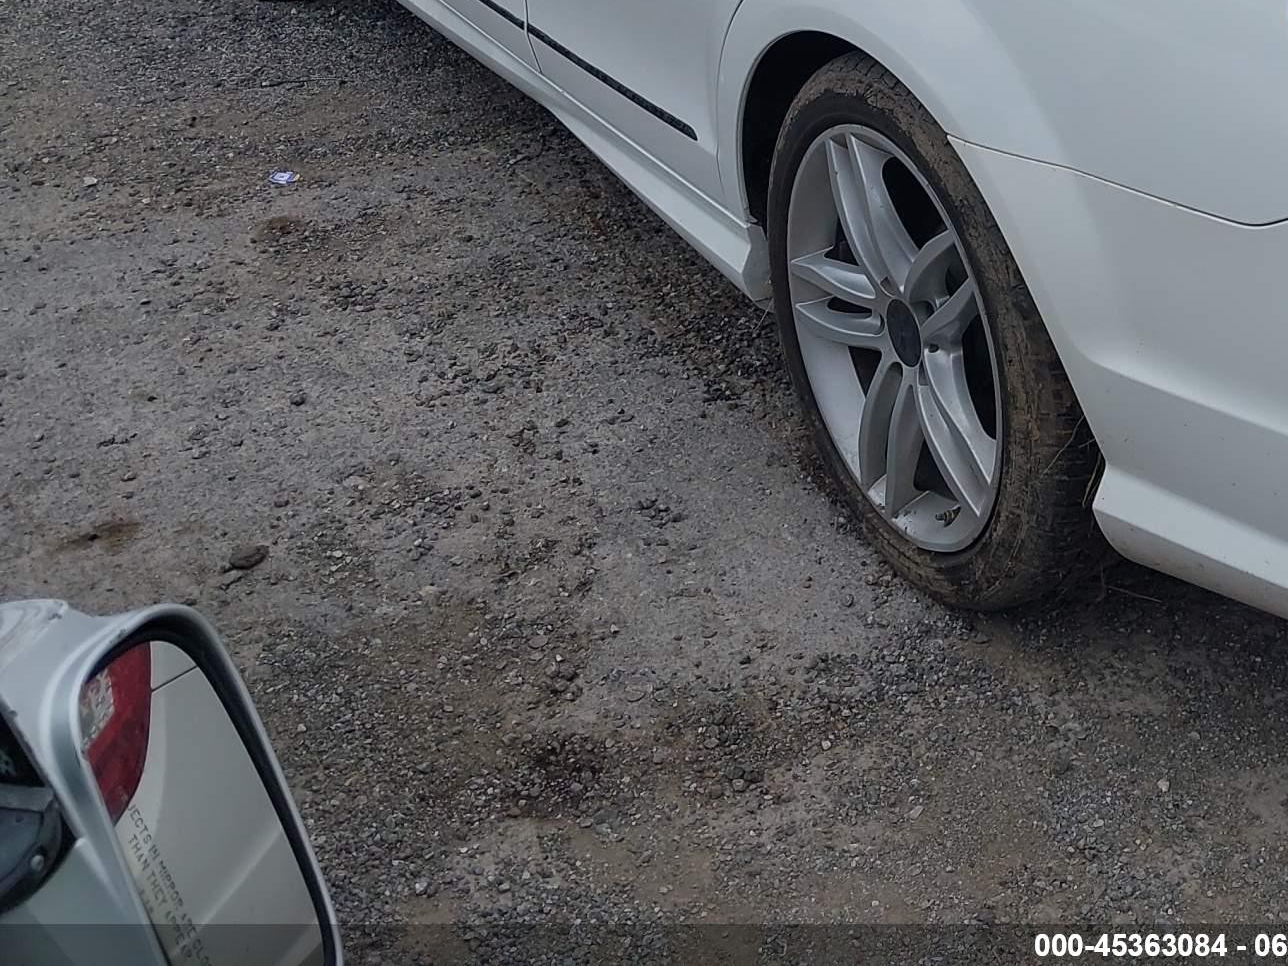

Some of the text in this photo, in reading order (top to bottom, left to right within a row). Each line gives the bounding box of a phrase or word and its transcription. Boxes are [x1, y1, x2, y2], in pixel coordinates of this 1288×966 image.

[127, 804, 152, 845] JECTS
[127, 834, 151, 872] THAN
[146, 871, 168, 908] THEY
